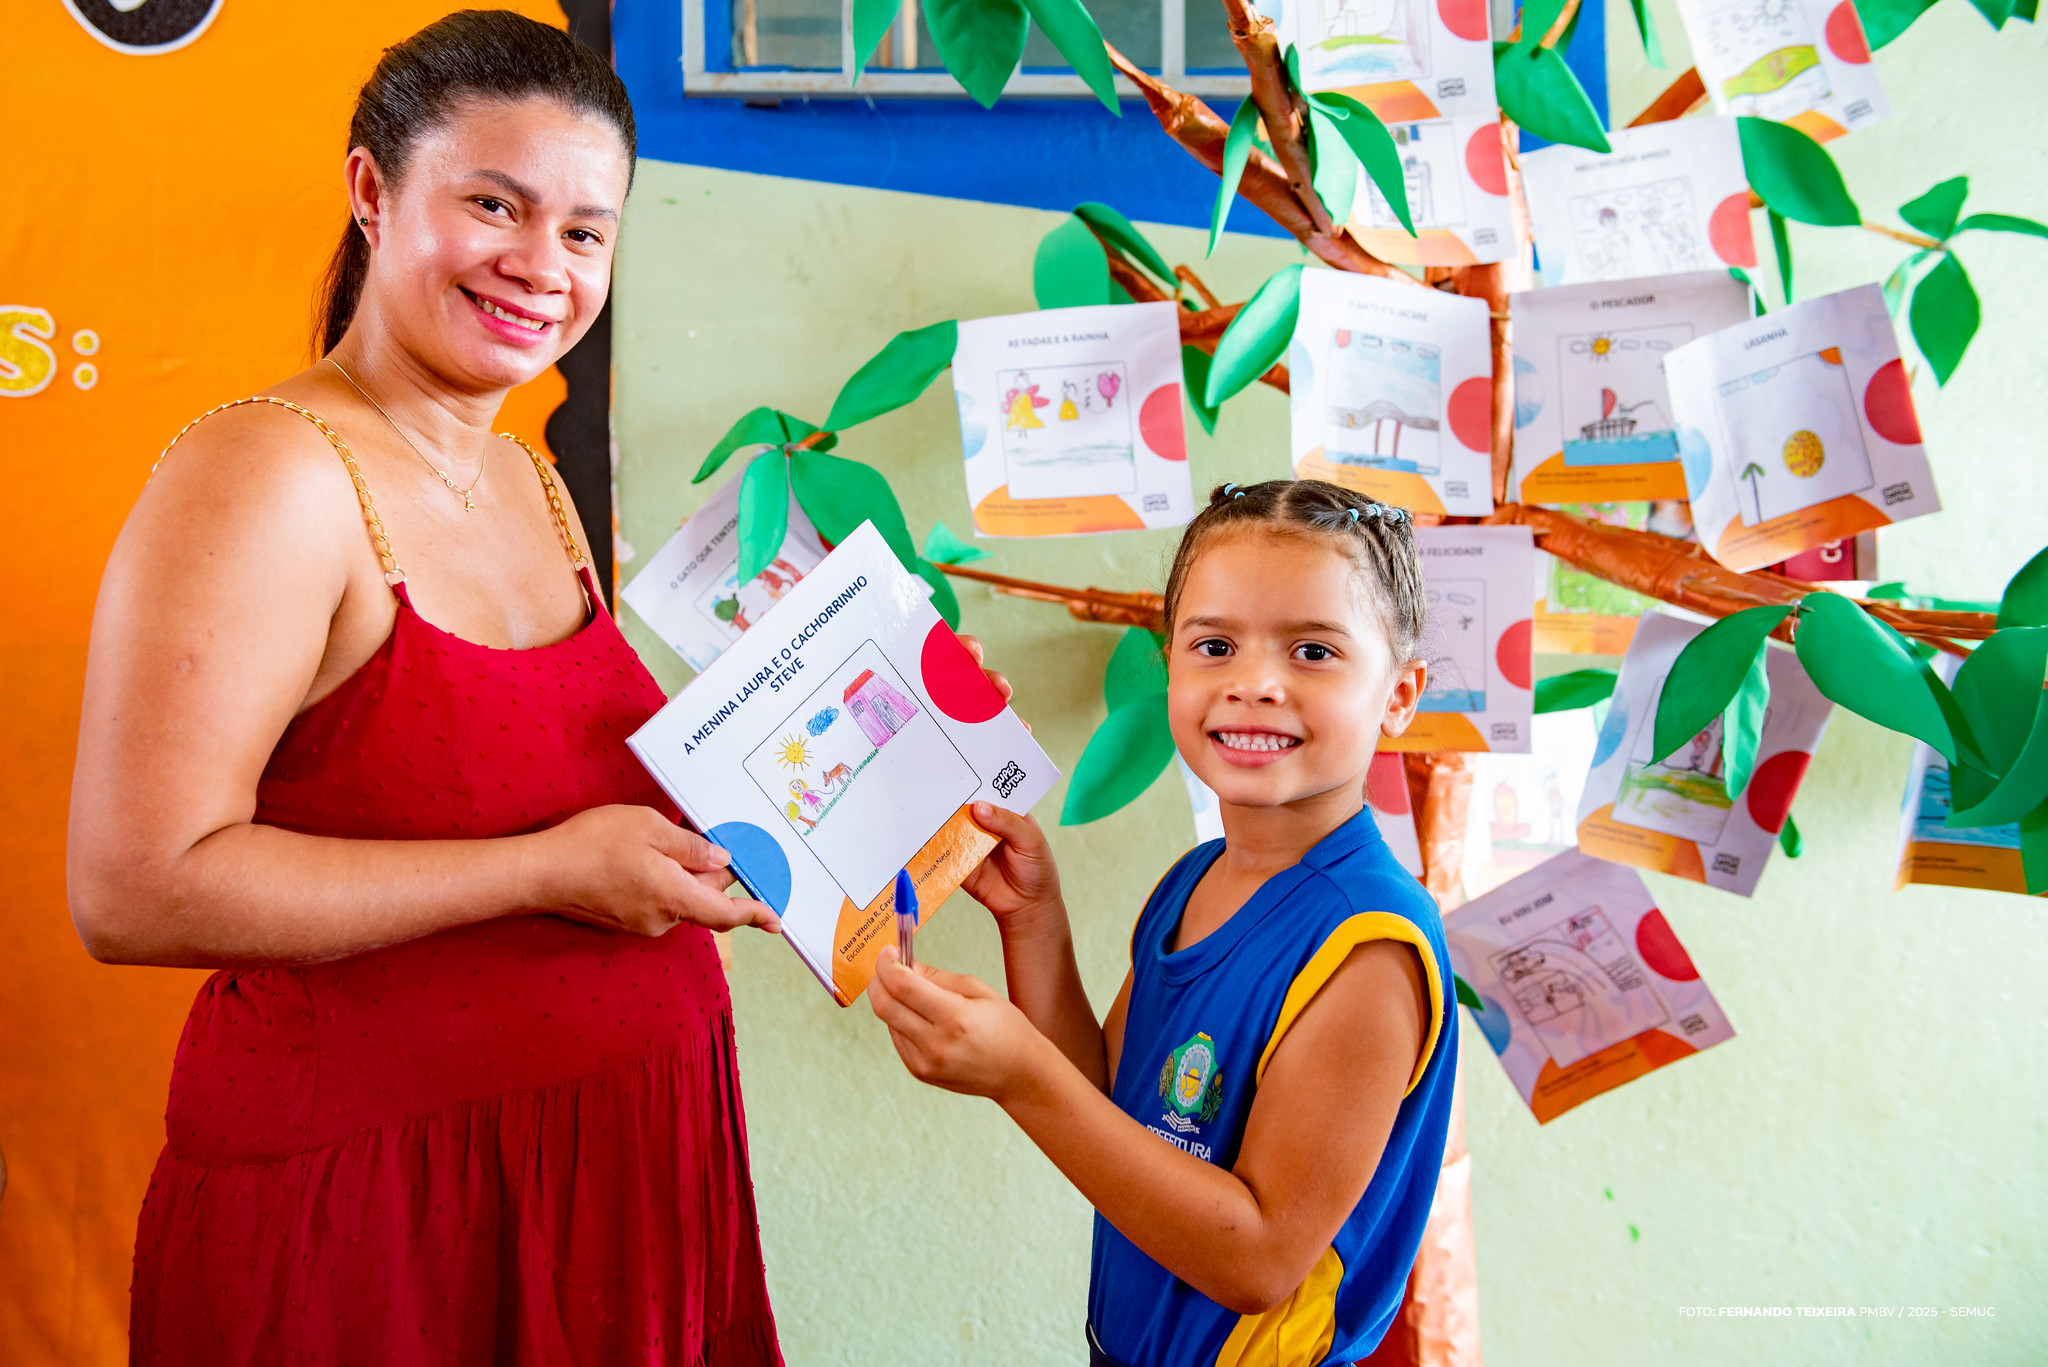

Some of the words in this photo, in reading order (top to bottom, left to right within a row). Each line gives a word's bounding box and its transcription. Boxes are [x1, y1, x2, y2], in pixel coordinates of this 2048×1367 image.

[1602, 293, 1656, 309] PESCADOR
[1022, 336, 1052, 346] FADAS
[1744, 328, 1789, 350] LASANHA
[677, 560, 698, 583] GATO
[695, 544, 713, 563] QUE
[1427, 546, 1483, 557] FELICIDADE
[683, 742, 695, 755] A
[692, 700, 739, 745] MENINA
[735, 666, 774, 703] LAURA
[771, 656, 783, 669] E
[780, 648, 792, 660] O
[790, 575, 868, 650] CACHORRINHO
[769, 657, 805, 693] STEVE
[993, 761, 1018, 790] SUPER
[1000, 769, 1026, 798] AUTOR
[916, 864, 938, 886] Feitosa
[935, 850, 951, 865] Neto
[839, 935, 857, 955] Laura
[845, 943, 866, 963] Escola
[863, 913, 892, 943] Municipal
